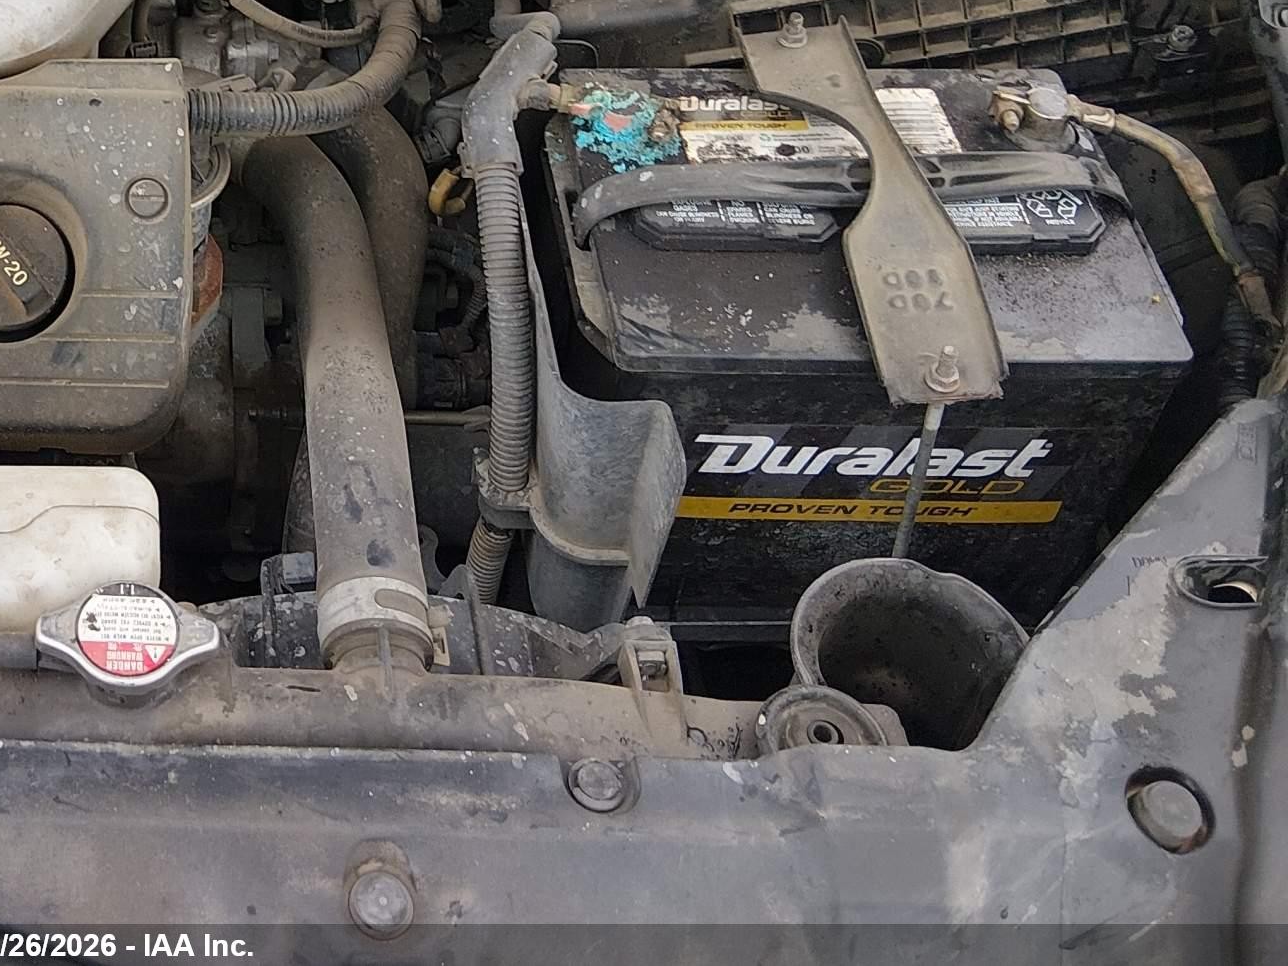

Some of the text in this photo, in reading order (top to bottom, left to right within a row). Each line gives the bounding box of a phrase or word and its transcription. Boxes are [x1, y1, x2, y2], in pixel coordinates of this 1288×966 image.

[694, 433, 1054, 478] Duralast
[869, 478, 1025, 495] GOLD
[728, 502, 858, 516] PROVEN
